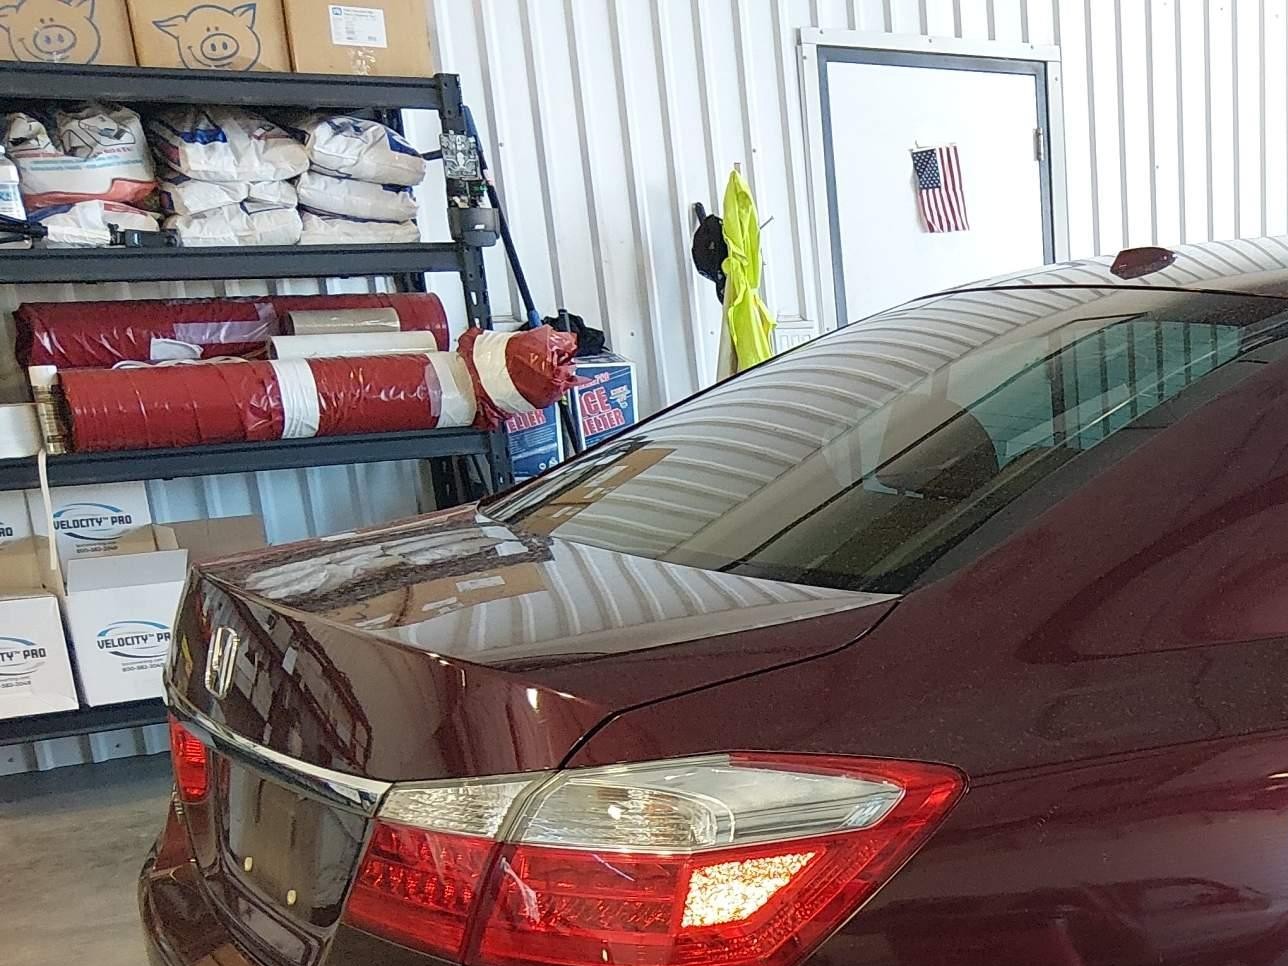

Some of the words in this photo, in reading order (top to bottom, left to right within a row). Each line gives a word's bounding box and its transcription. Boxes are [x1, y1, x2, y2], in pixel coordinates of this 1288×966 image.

[579, 386, 612, 416] ICE
[504, 408, 547, 434] ELTER
[110, 514, 133, 526] PRO
[156, 631, 171, 642] PR
[23, 647, 47, 660] PRO
